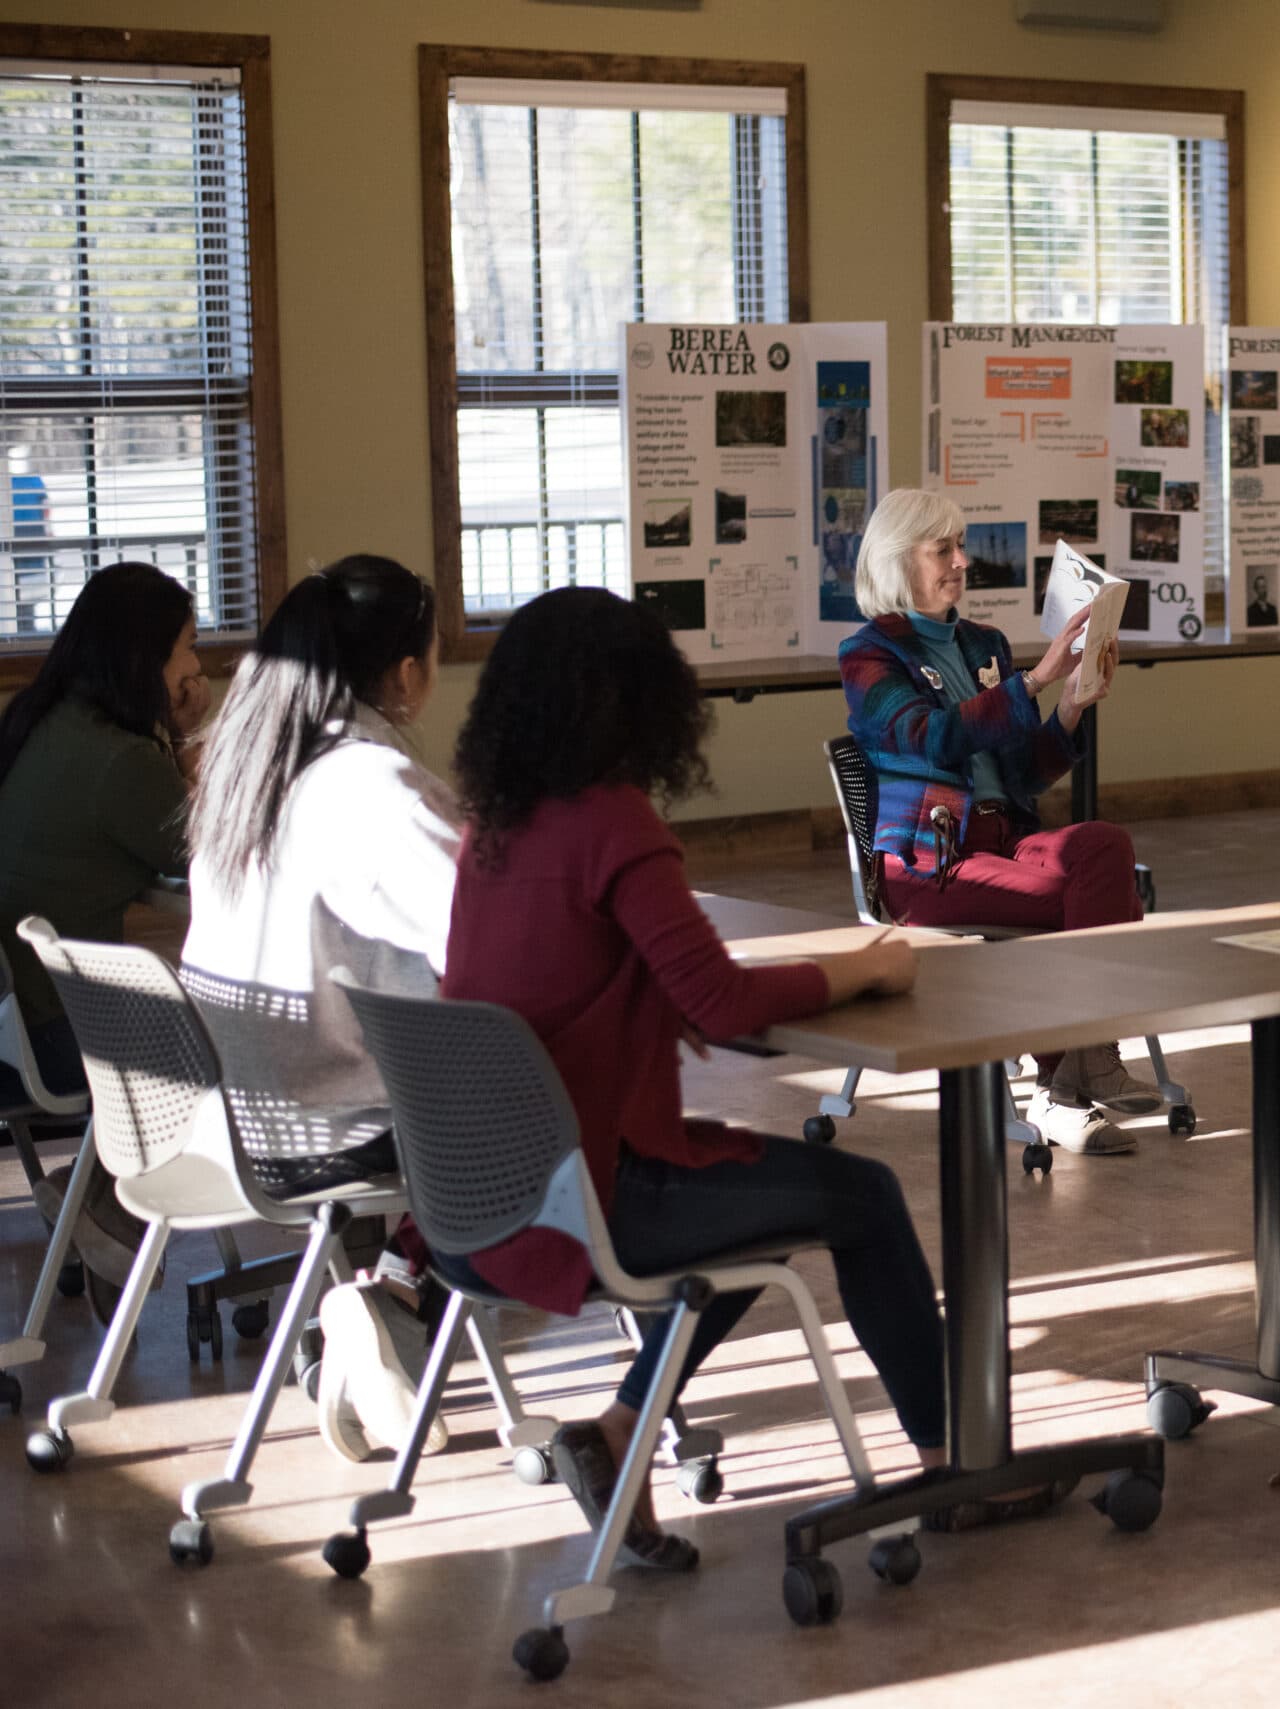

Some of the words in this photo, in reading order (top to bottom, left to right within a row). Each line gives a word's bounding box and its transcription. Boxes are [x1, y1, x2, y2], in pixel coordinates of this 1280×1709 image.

[669, 328, 751, 351] BEREA
[943, 326, 1005, 348] FOREST
[1011, 327, 1117, 348] MANAGEMENT
[666, 352, 757, 375] WATER
